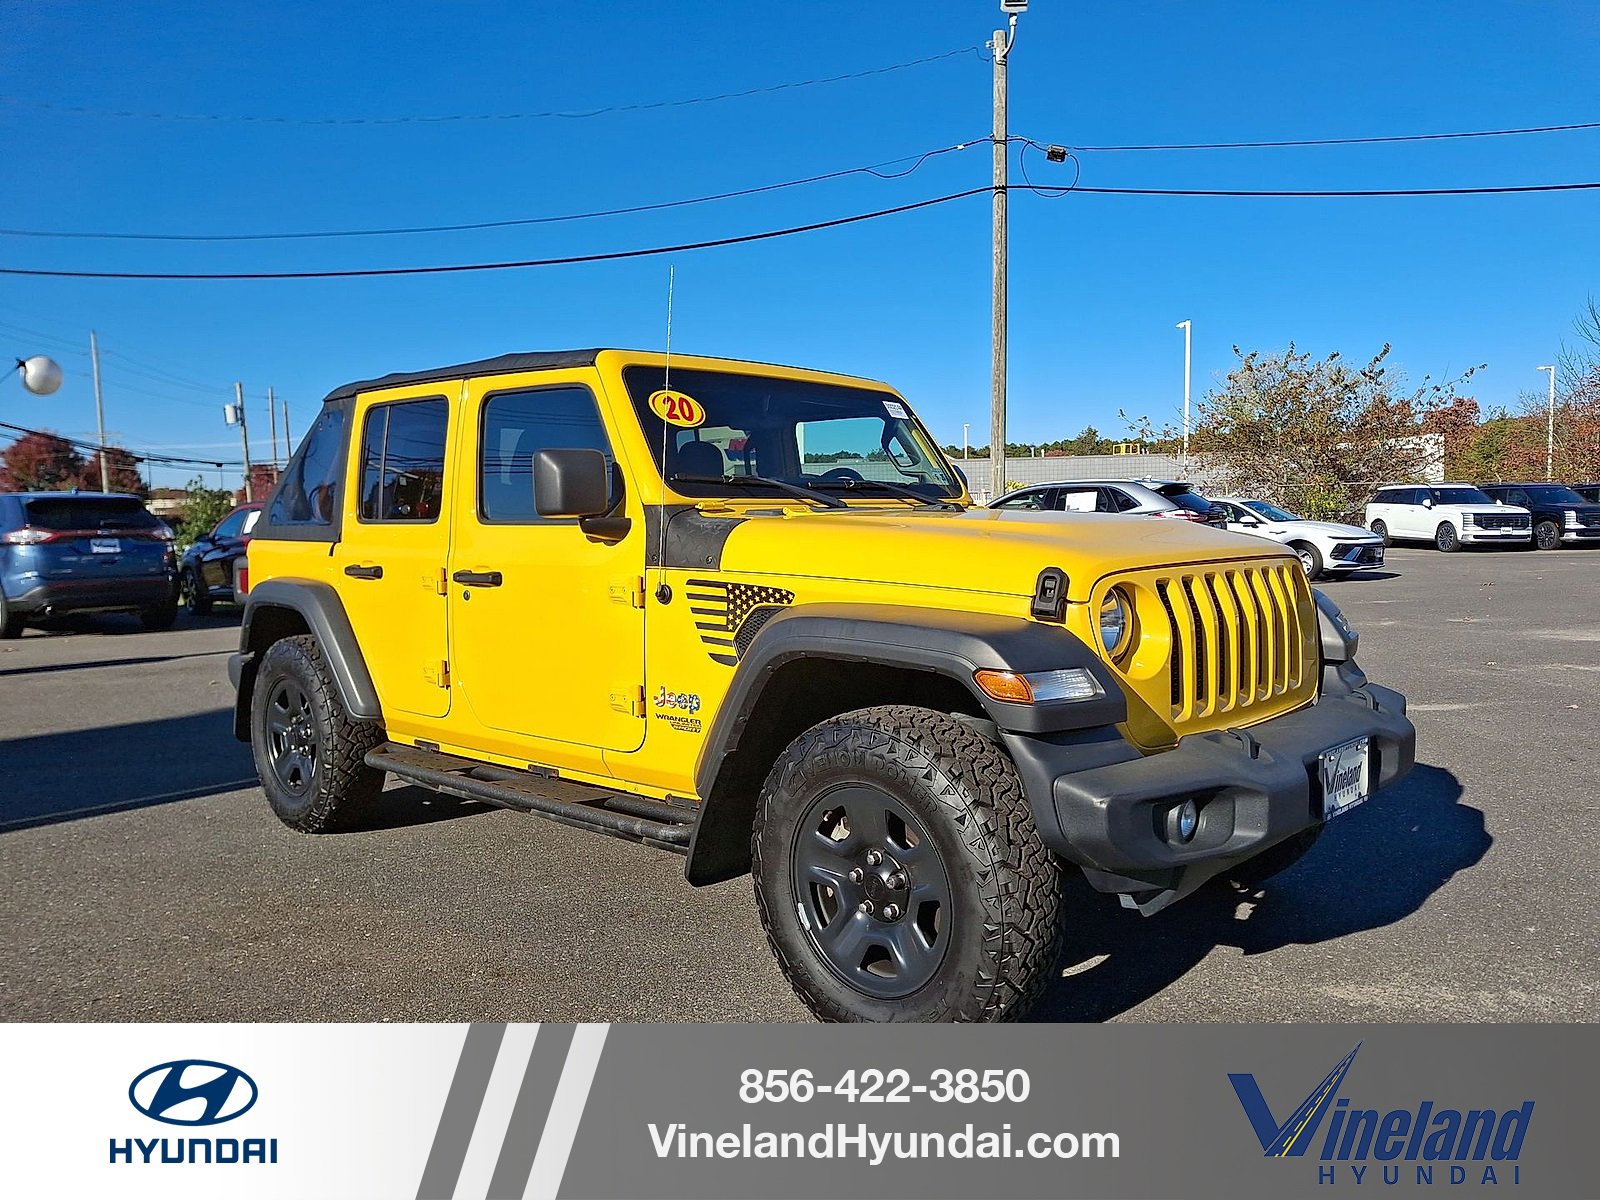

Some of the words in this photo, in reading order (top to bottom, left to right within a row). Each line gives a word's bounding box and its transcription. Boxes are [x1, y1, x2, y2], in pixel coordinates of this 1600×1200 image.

[662, 395, 694, 422] 20
[653, 686, 700, 714] Jeep
[655, 713, 701, 725] WRANGLER
[1324, 752, 1363, 795] Vineland
